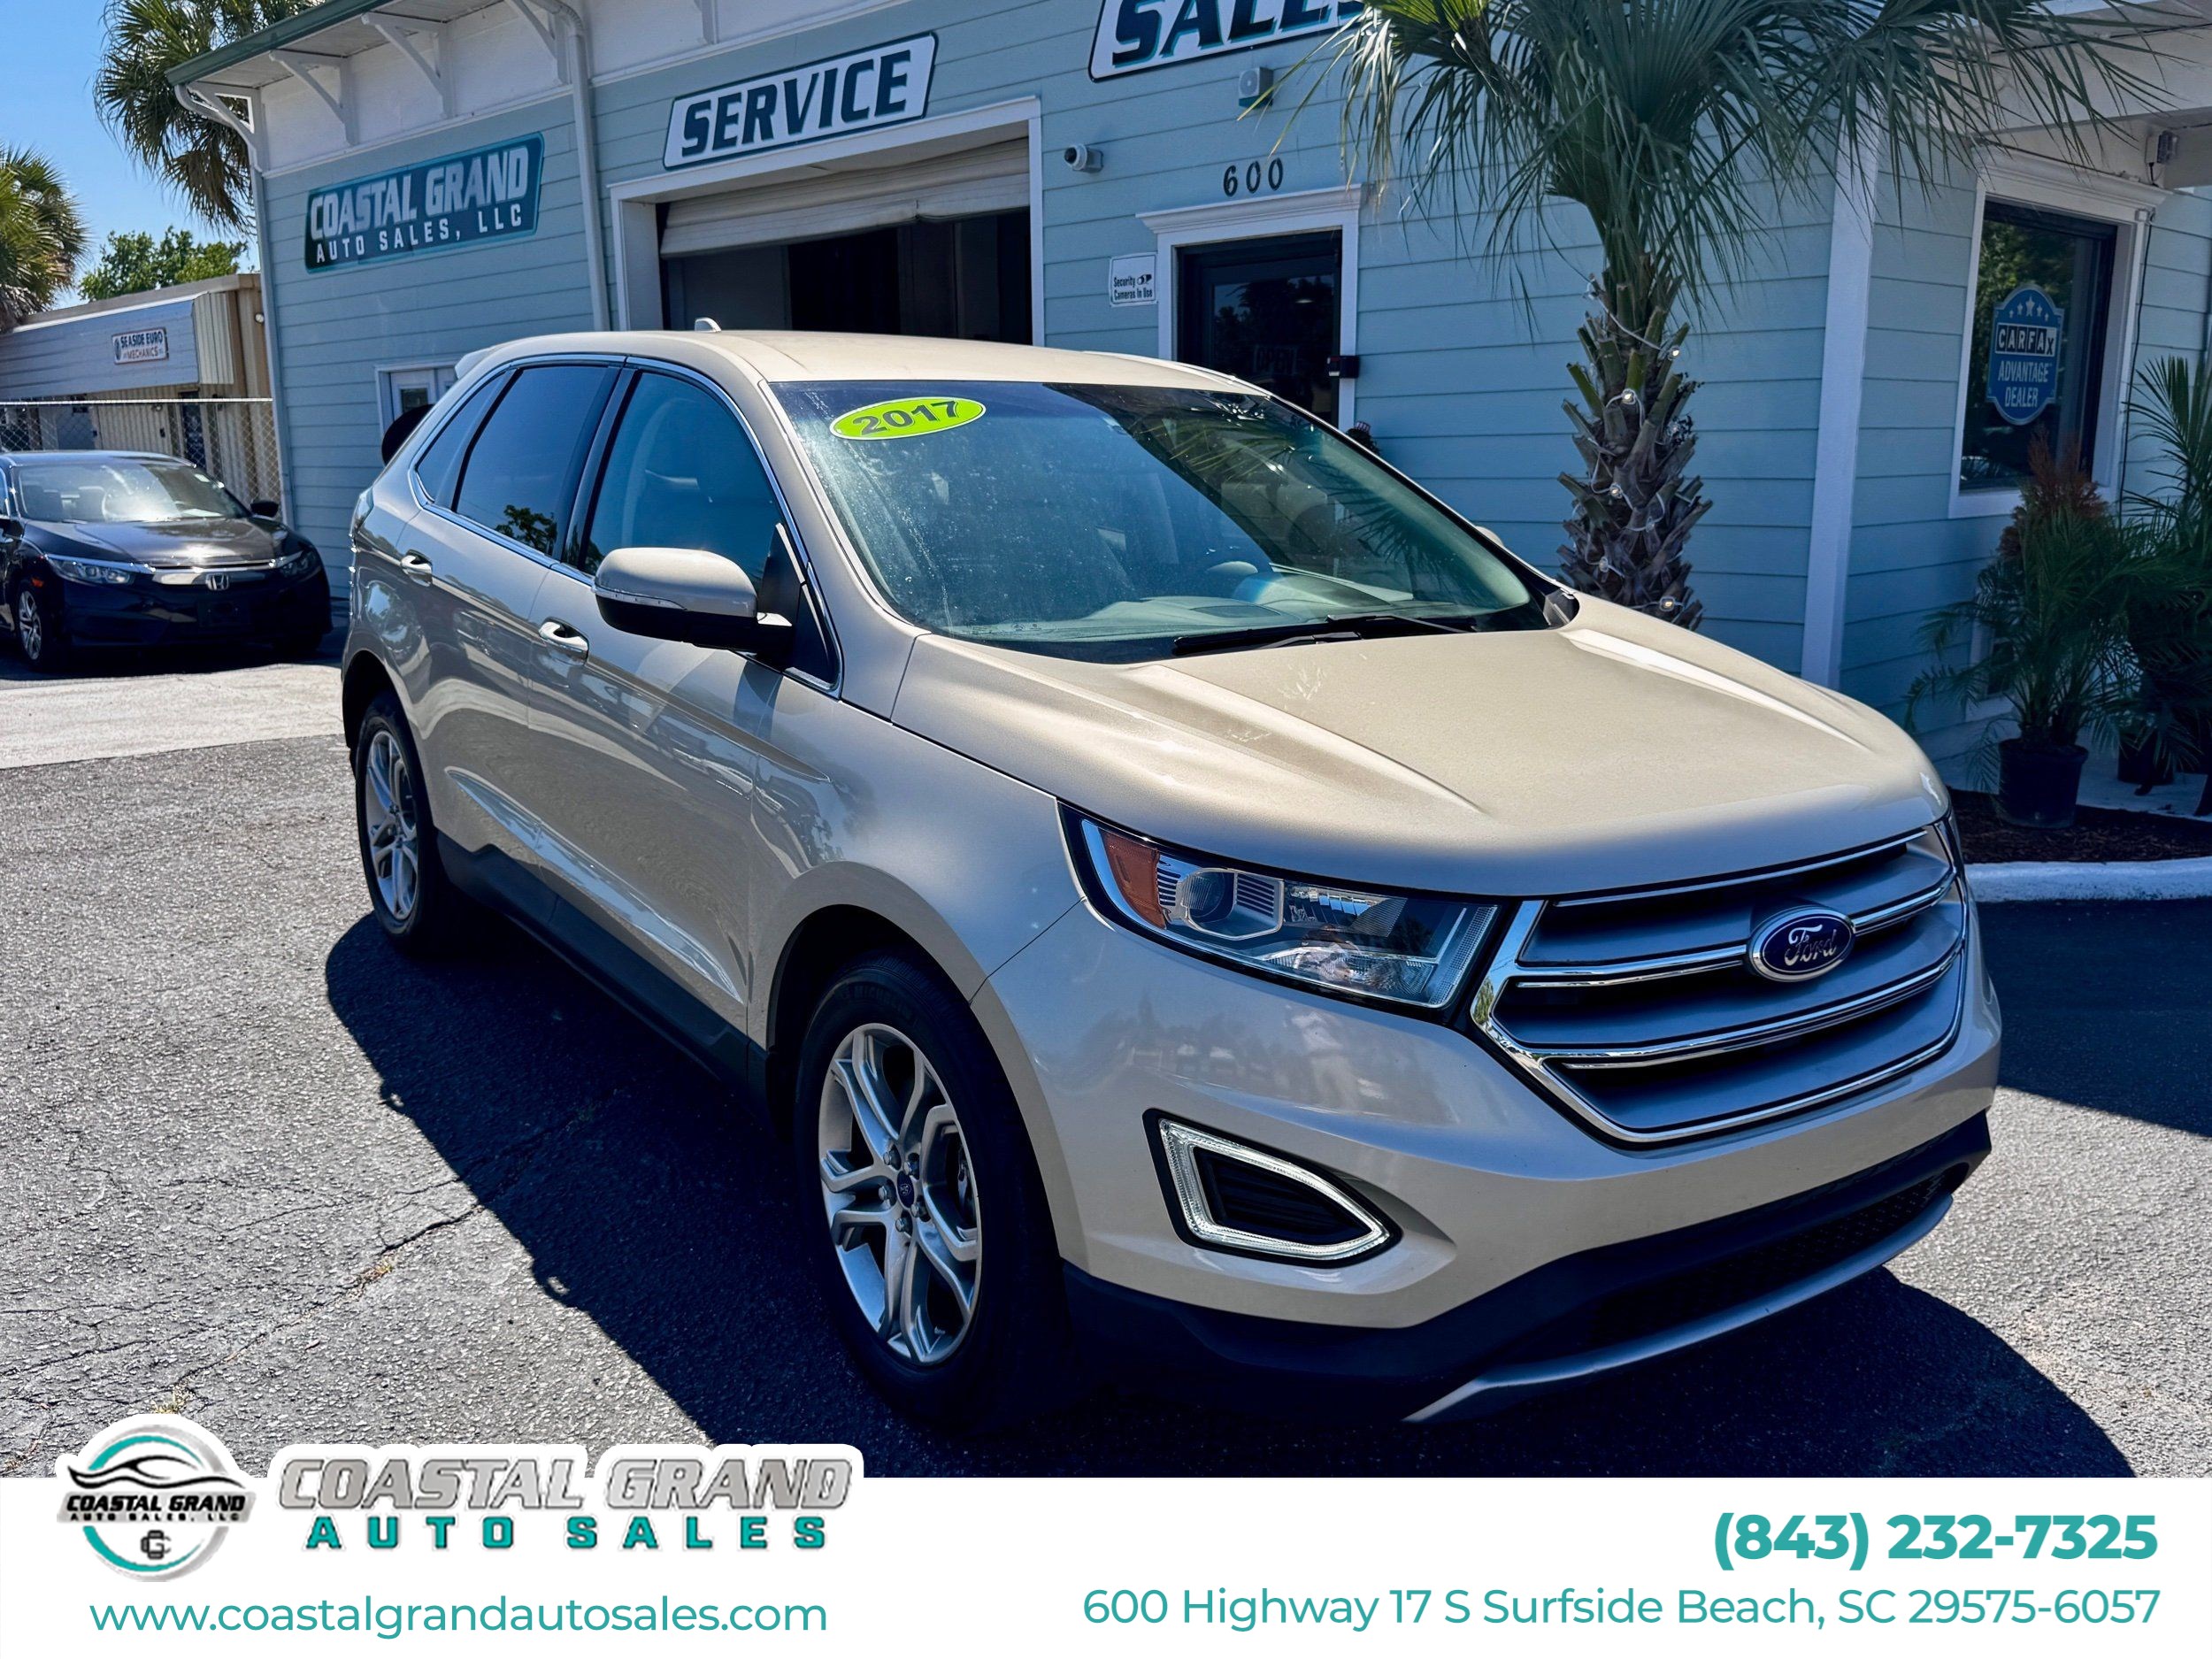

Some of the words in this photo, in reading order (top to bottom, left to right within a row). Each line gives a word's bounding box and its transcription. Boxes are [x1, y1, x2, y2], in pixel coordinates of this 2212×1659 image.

[681, 50, 911, 157] SERVICE
[311, 174, 418, 241] COASTAL
[426, 145, 529, 218] GRAND
[1223, 157, 1284, 197] 600
[316, 235, 365, 263] AUTO
[379, 219, 461, 251] SALES,
[478, 203, 522, 234] LLC
[1113, 276, 1136, 288] Security
[120, 333, 145, 348] SEASIDE
[146, 331, 164, 344] EURO
[1998, 328, 2055, 355] CARFAX
[1998, 360, 2048, 382] ADVANTAGE
[2005, 387, 2039, 407] DEALER
[852, 400, 960, 435] 2017
[1784, 924, 1838, 966] Ford
